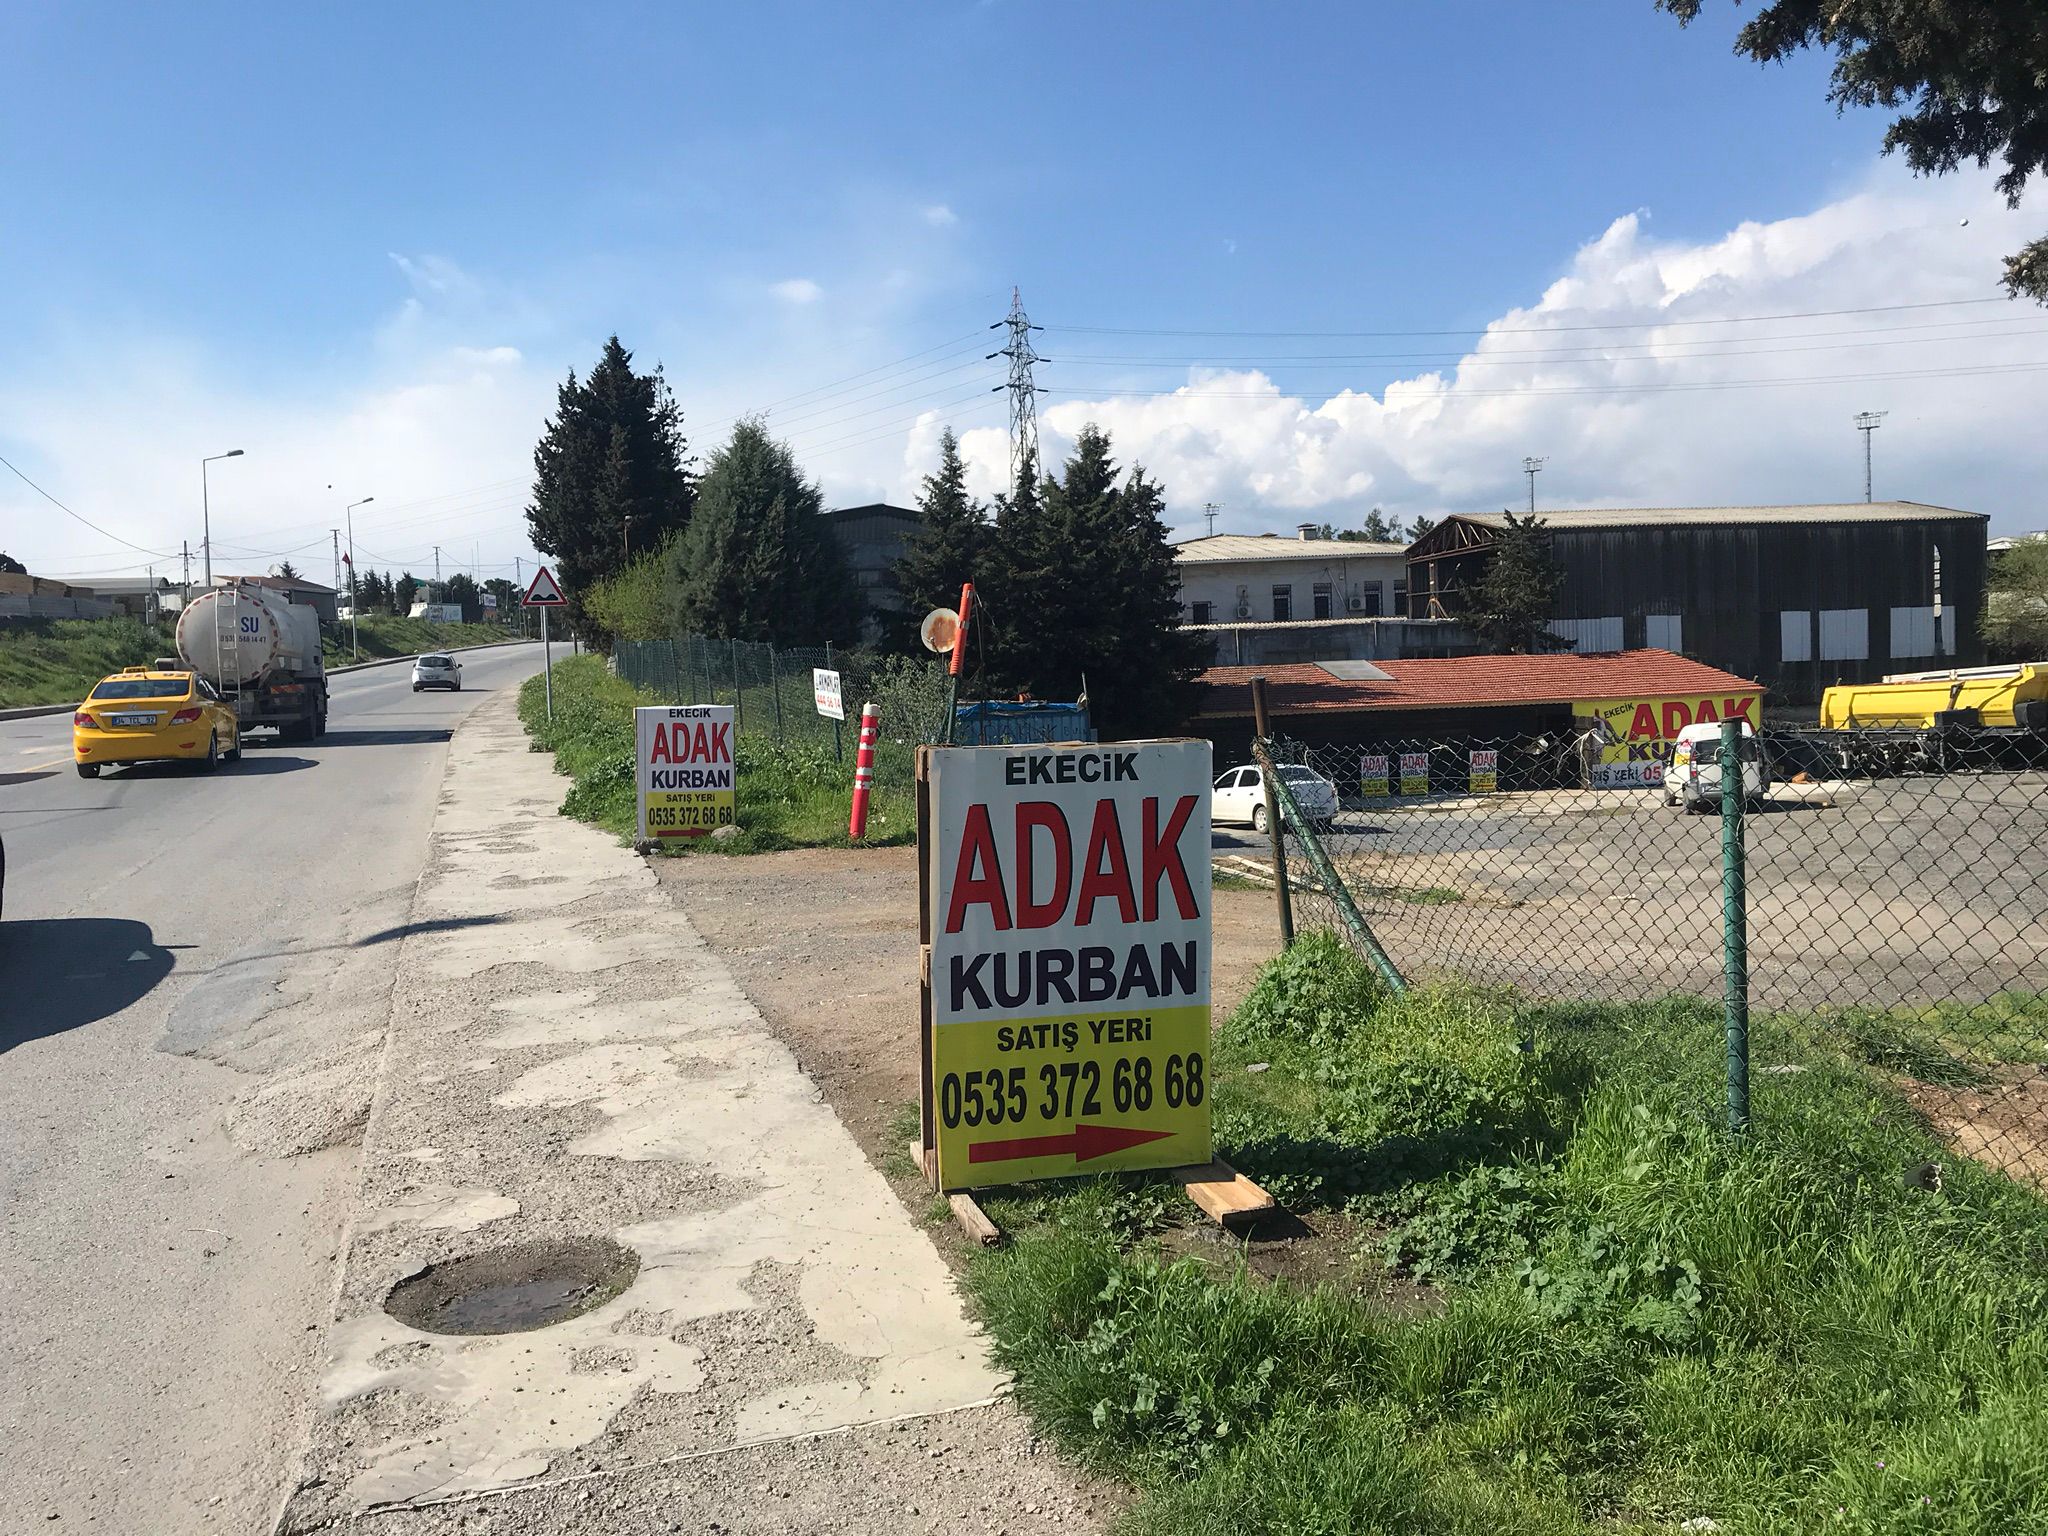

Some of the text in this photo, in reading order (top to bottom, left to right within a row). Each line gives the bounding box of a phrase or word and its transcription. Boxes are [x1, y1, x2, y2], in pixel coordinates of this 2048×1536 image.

[240, 616, 259, 633] SU
[1628, 697, 1755, 741] ADAK
[651, 722, 731, 764] ADAK
[1401, 755, 1427, 769] ADAK
[1471, 752, 1496, 766] ADAK
[651, 770, 730, 788] KURBAN
[1643, 766, 1662, 780] 05
[666, 794, 692, 803] SATIŞ
[649, 806, 732, 825] 0535 372 68 68
[945, 795, 1200, 934] ADAK
[950, 940, 1197, 1012] KURBAN
[996, 1021, 1079, 1054] SATIŞ
[941, 1052, 1204, 1130] 0535 372 68 68
